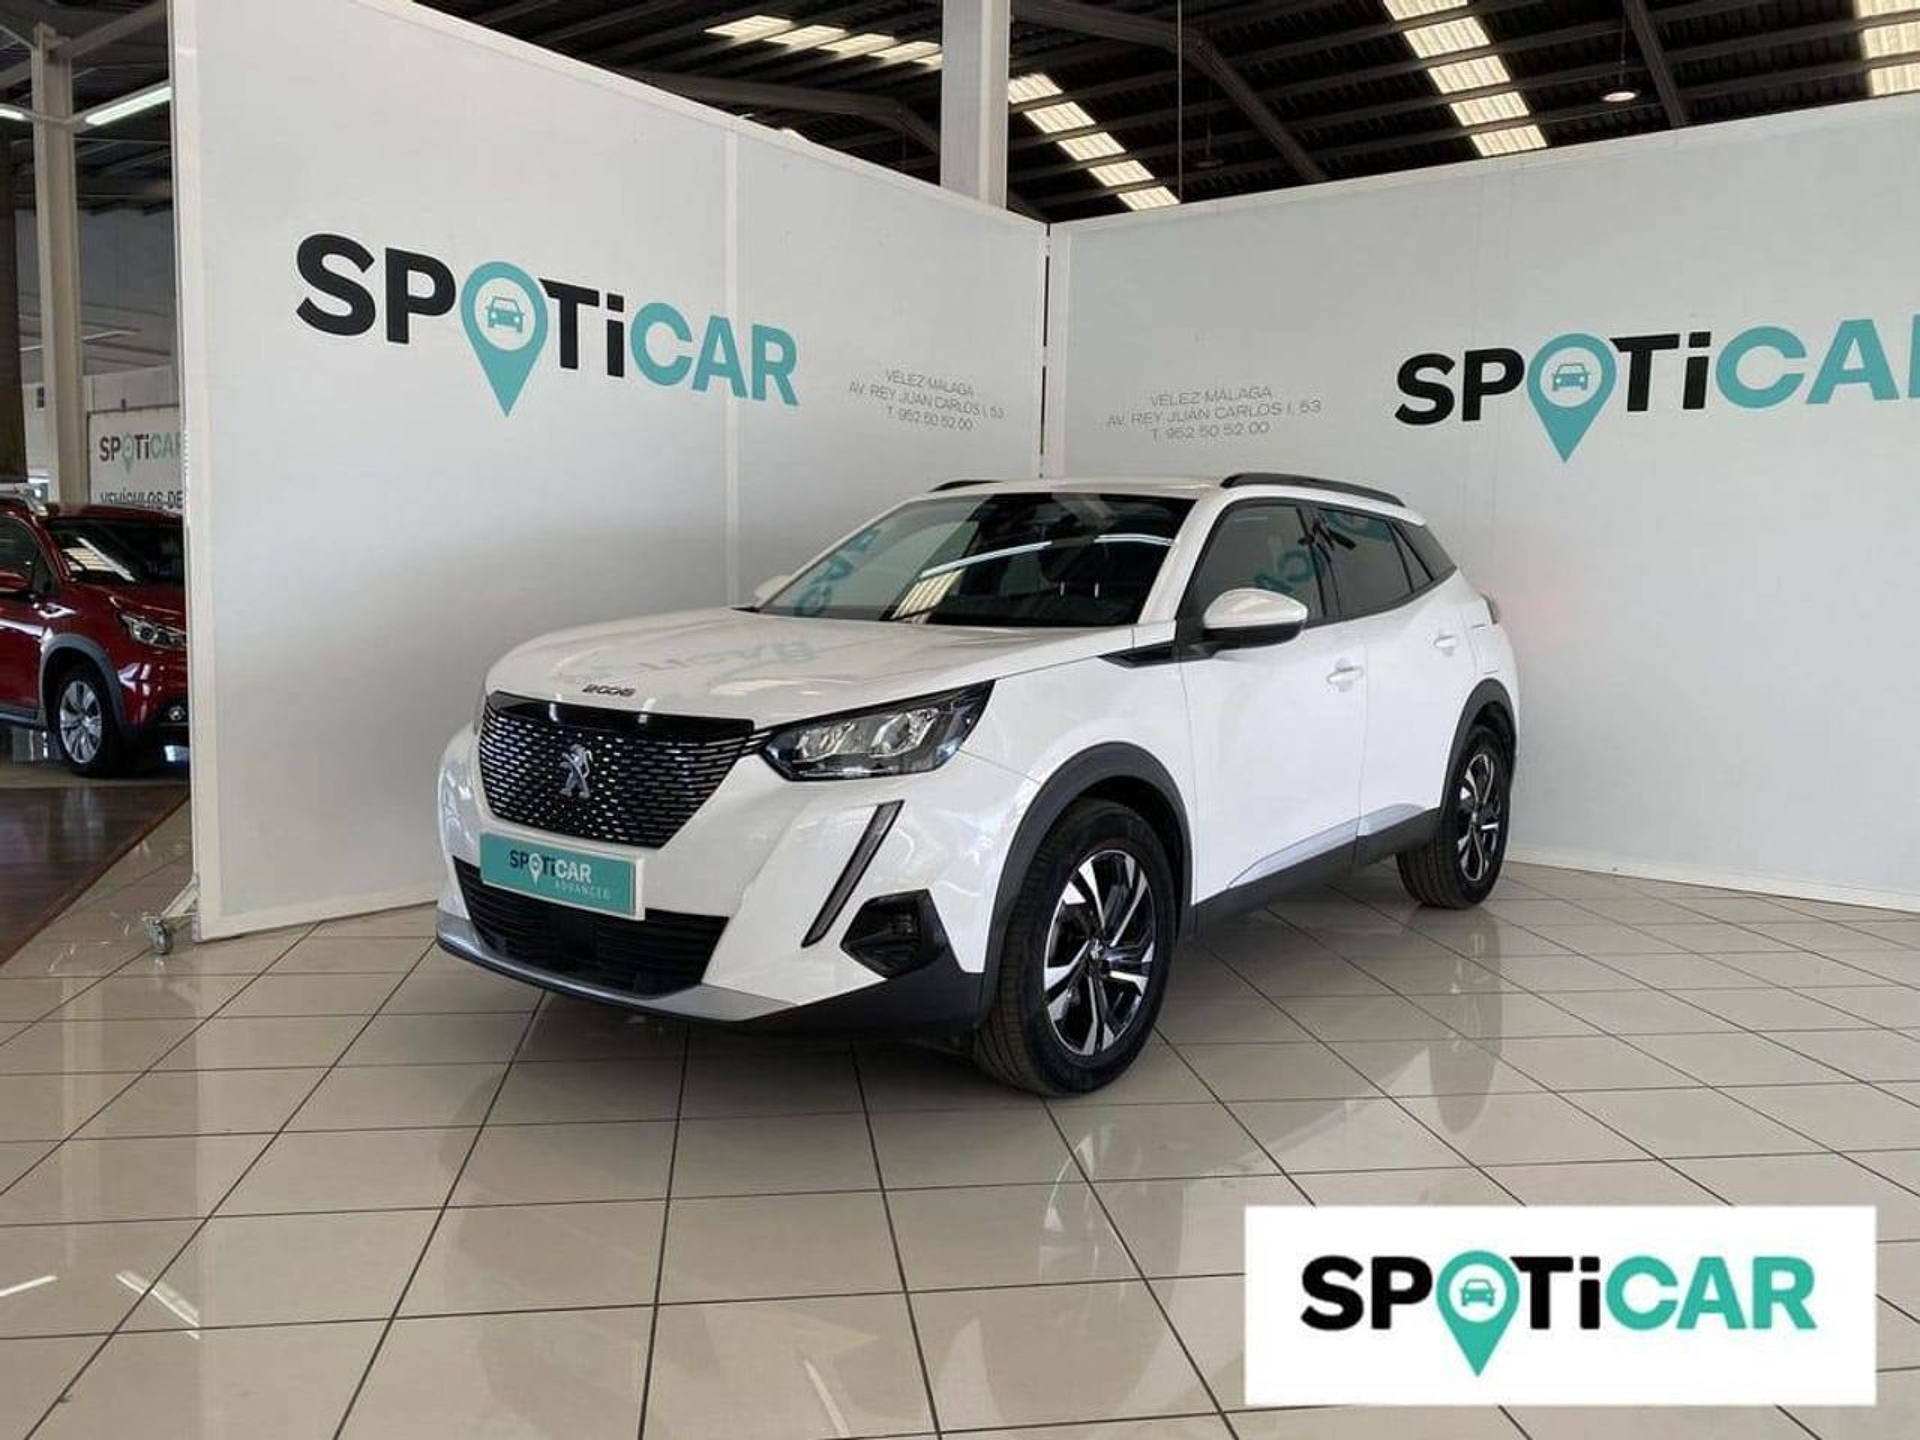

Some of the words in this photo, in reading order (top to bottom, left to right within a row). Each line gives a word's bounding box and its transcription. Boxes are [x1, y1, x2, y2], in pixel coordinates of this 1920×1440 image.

[870, 383, 896, 400] REY
[899, 391, 933, 408] JUAN
[935, 396, 980, 416] CARLOS
[1394, 312, 1920, 463] SPOTiCA
[1131, 410, 1163, 425] REY
[1167, 408, 1210, 423] JUAN
[1214, 401, 1282, 420] CARLOS
[1166, 426, 1195, 440] 952
[1248, 420, 1270, 434] 00
